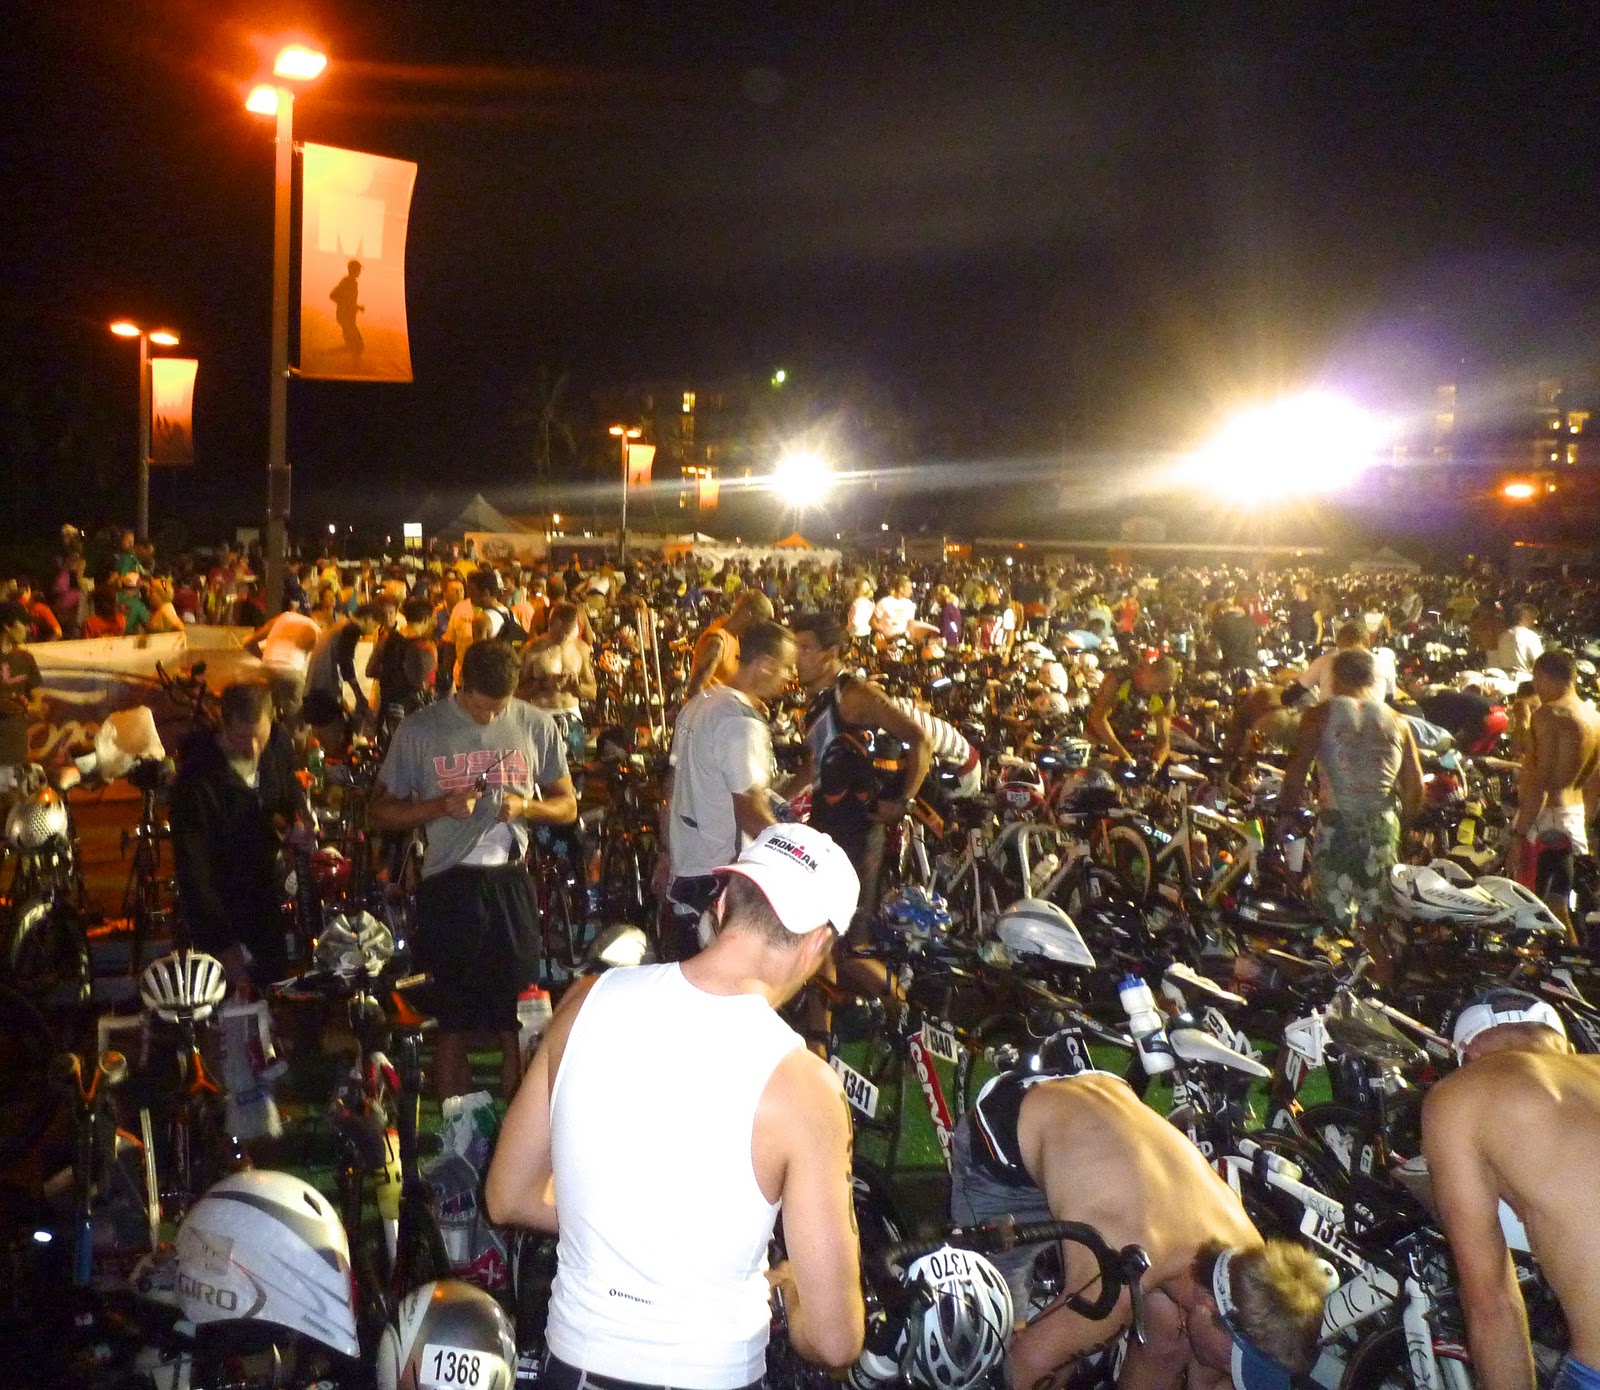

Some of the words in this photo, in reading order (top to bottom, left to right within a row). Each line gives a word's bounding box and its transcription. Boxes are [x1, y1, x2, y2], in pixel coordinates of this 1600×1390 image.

[767, 837, 819, 871] IRONMAN
[843, 1069, 872, 1111] 1341
[930, 1252, 972, 1280] 1370
[178, 1271, 238, 1312] GIRO
[433, 1350, 481, 1387] 1368
